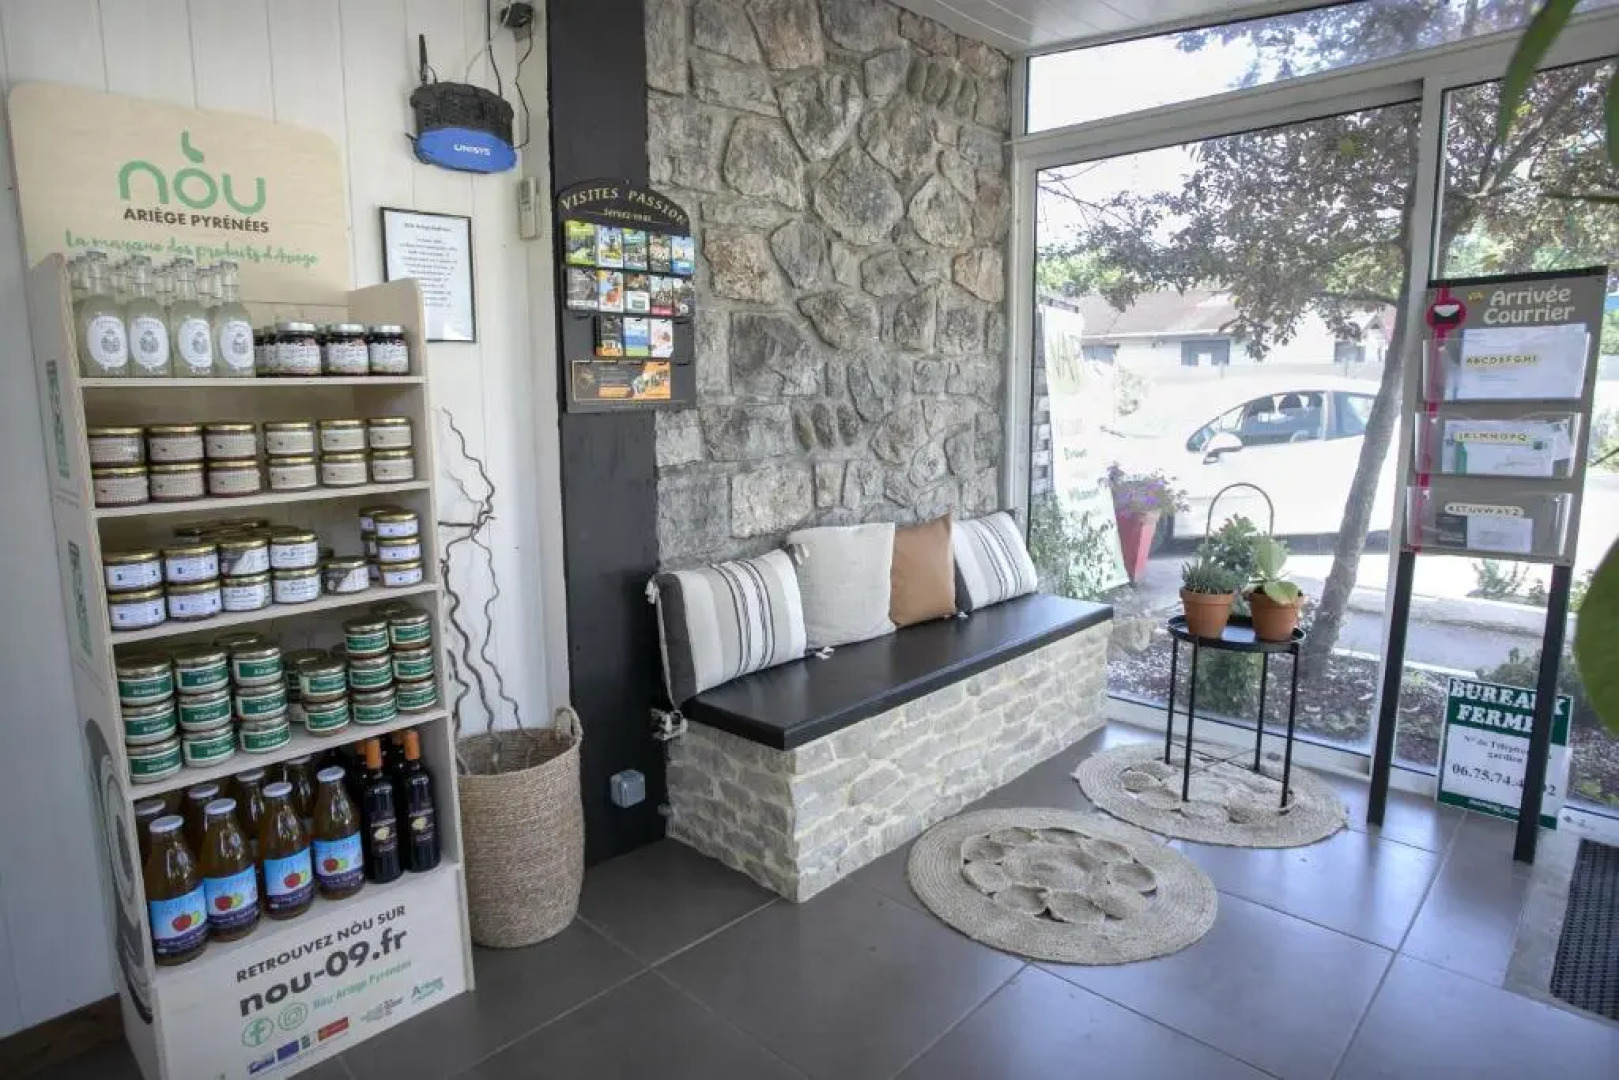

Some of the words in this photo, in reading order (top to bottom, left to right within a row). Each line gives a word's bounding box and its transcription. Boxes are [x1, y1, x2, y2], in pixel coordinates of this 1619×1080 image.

[561, 187, 619, 211] VISITES
[124, 207, 186, 226] ARIÈGE
[190, 214, 270, 233] PYRÉNÉES
[1490, 285, 1571, 306] Arrivée
[1483, 303, 1575, 325] Courrier
[236, 934, 333, 983] RETROUVEZ
[377, 905, 406, 925] SUR
[239, 927, 408, 1017] nou-09.fr
